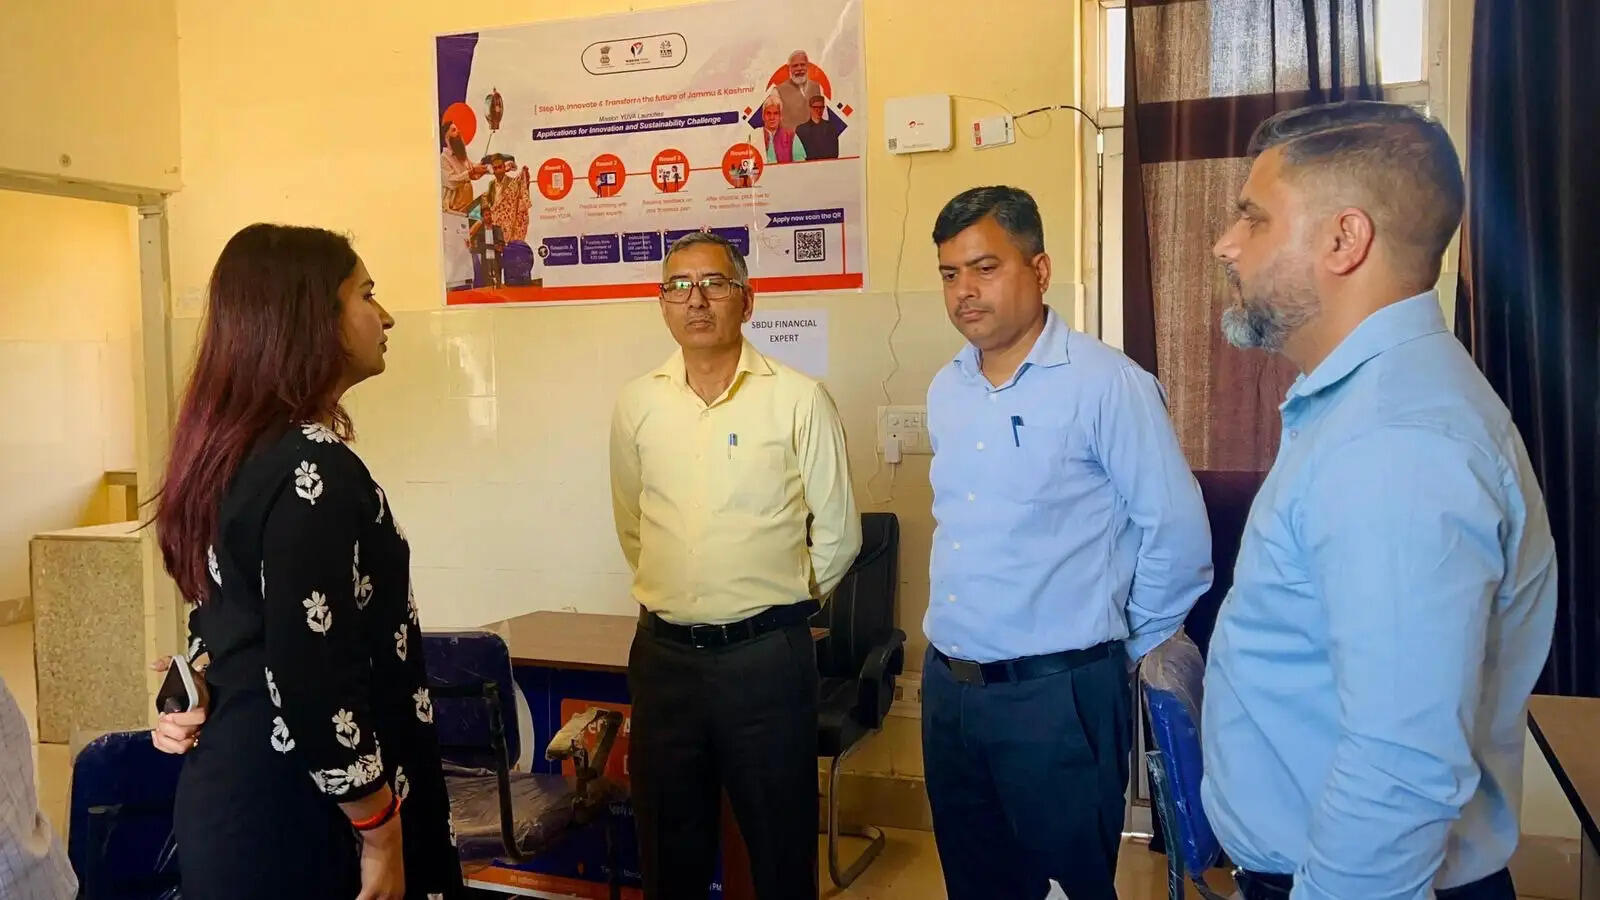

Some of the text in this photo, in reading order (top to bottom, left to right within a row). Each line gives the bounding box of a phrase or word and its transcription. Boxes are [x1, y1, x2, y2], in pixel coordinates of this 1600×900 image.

[538, 105, 554, 114] Step
[566, 101, 597, 110] Innovate
[605, 97, 640, 106] Transform
[642, 95, 655, 103] the
[655, 93, 677, 102] future
[687, 89, 716, 99] Jammu
[718, 88, 722, 96] &
[724, 86, 754, 95] Kashmir
[620, 113, 636, 121] YUVA
[536, 115, 722, 139] Applications for Innovation and Sustainability Challenge
[772, 211, 842, 225] Apply now scan the QR
[751, 319, 817, 329] SBDU FINANCIAL
[769, 334, 799, 342] EXPERT
